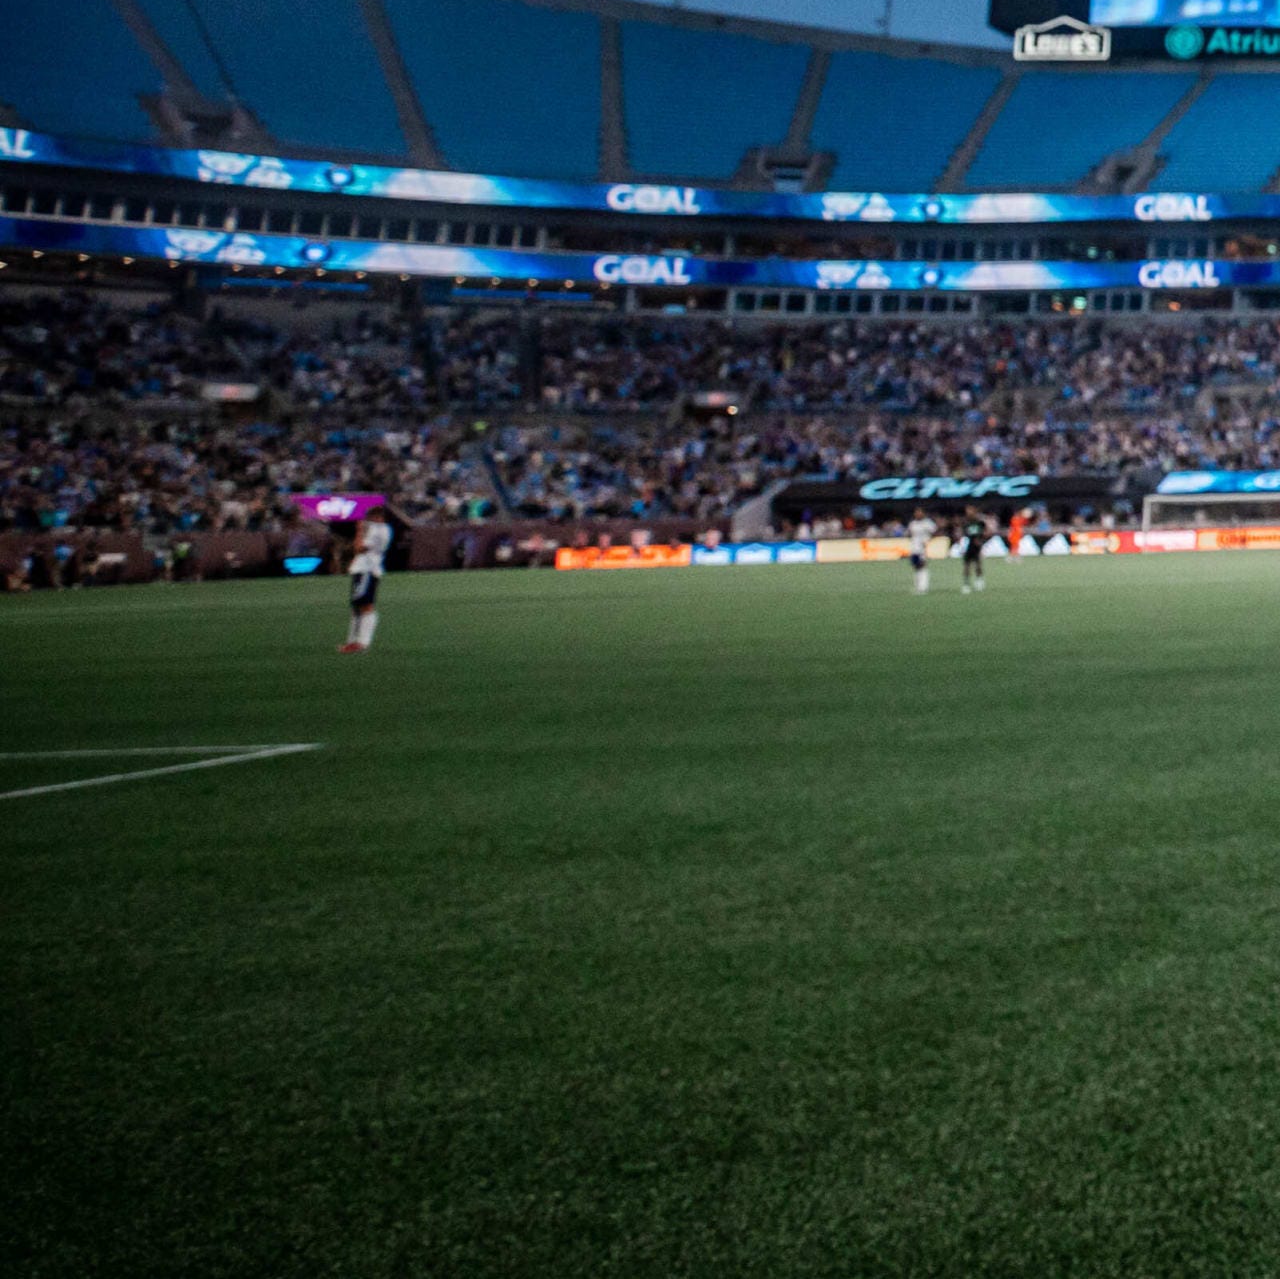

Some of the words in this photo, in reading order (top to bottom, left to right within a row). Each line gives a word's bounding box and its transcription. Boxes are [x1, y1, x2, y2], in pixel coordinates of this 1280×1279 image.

[606, 183, 700, 214] GOAL
[1134, 195, 1212, 221] GOAL
[593, 255, 691, 285] GOAL
[1138, 260, 1220, 288] GOAL
